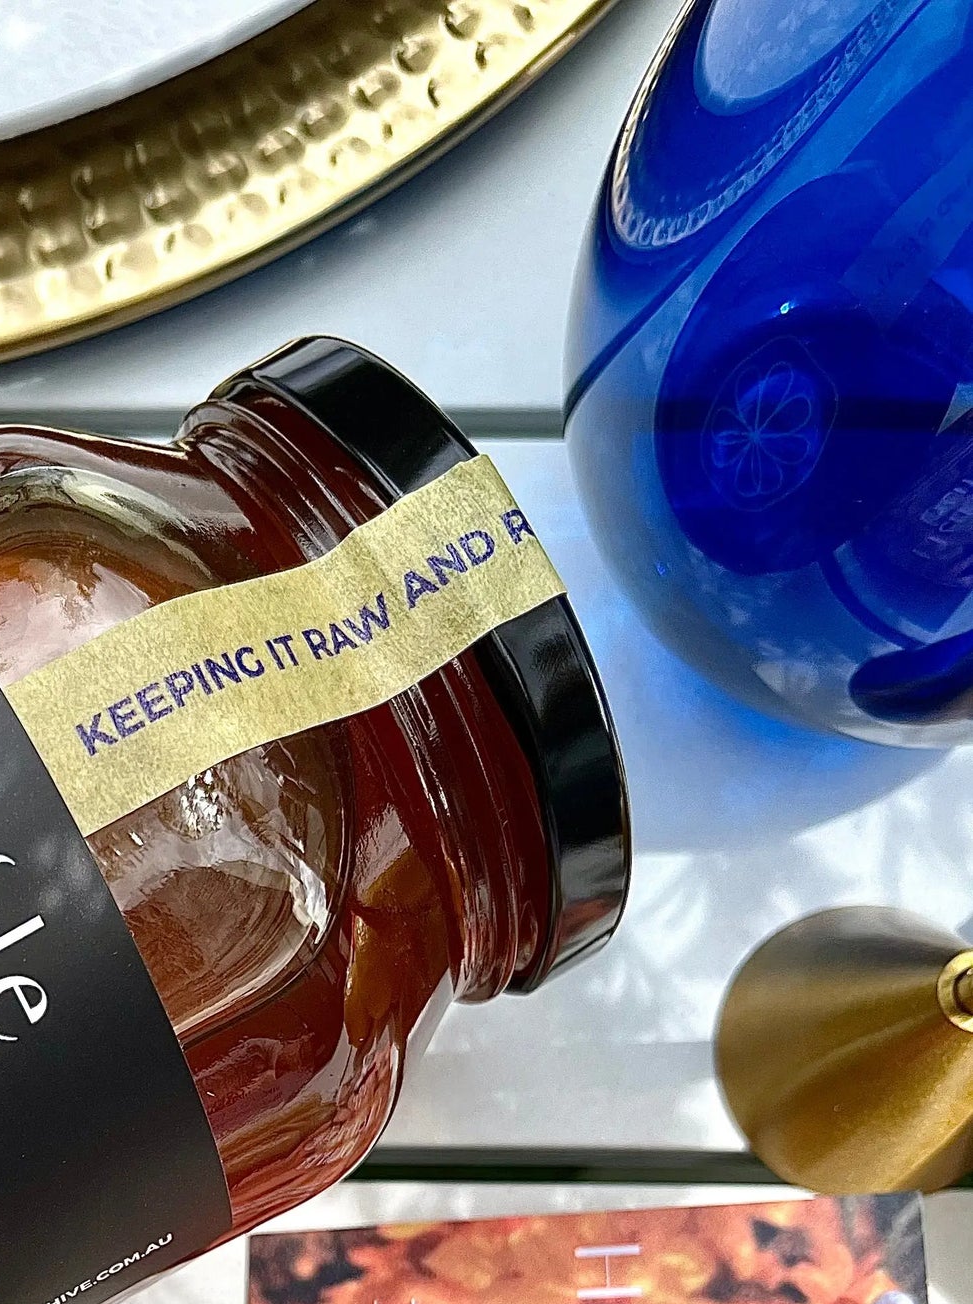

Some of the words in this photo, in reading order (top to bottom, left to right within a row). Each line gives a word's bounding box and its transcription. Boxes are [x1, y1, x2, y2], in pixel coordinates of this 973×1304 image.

[75, 646, 265, 756] KEEPING
[269, 636, 299, 671] IT
[301, 593, 392, 660] RAW
[404, 529, 496, 610] AND
